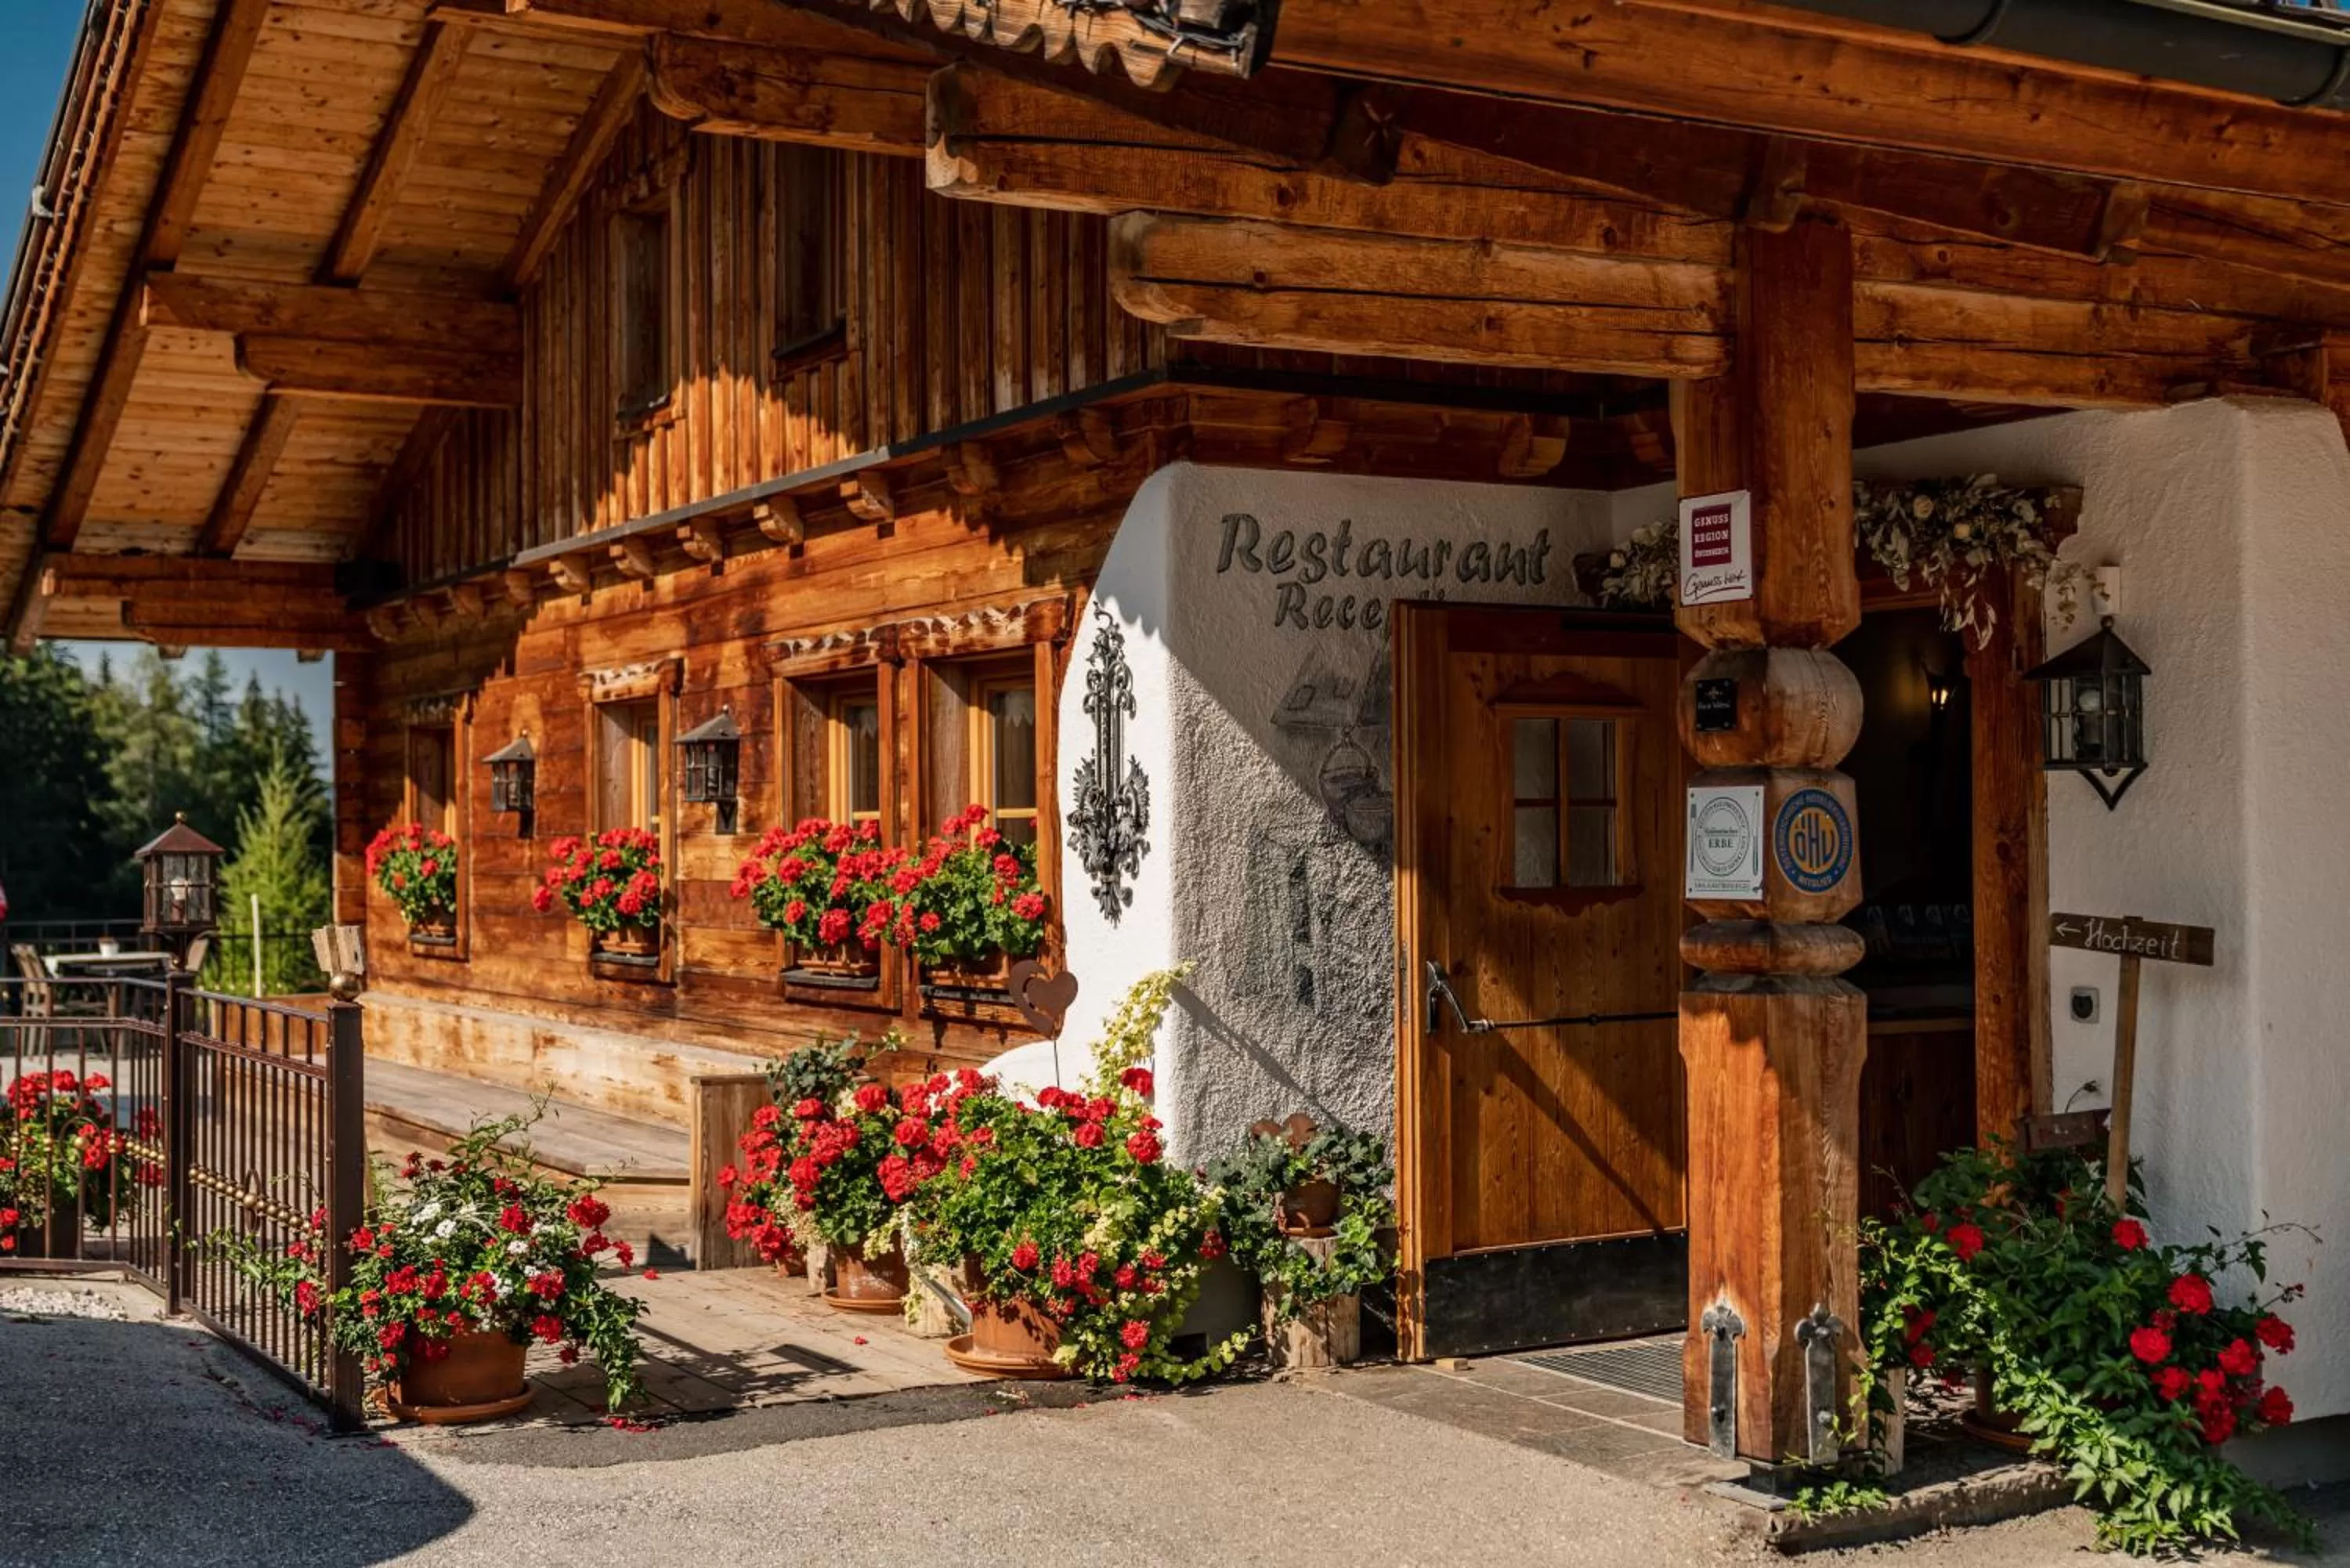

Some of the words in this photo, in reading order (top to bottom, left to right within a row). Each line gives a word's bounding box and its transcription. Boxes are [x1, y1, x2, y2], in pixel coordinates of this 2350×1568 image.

[1694, 513, 1729, 527] GENUSS
[1217, 512, 1551, 585] Restaurant
[1694, 529, 1729, 543] REGION
[2084, 917, 2180, 960] Hochzeit
